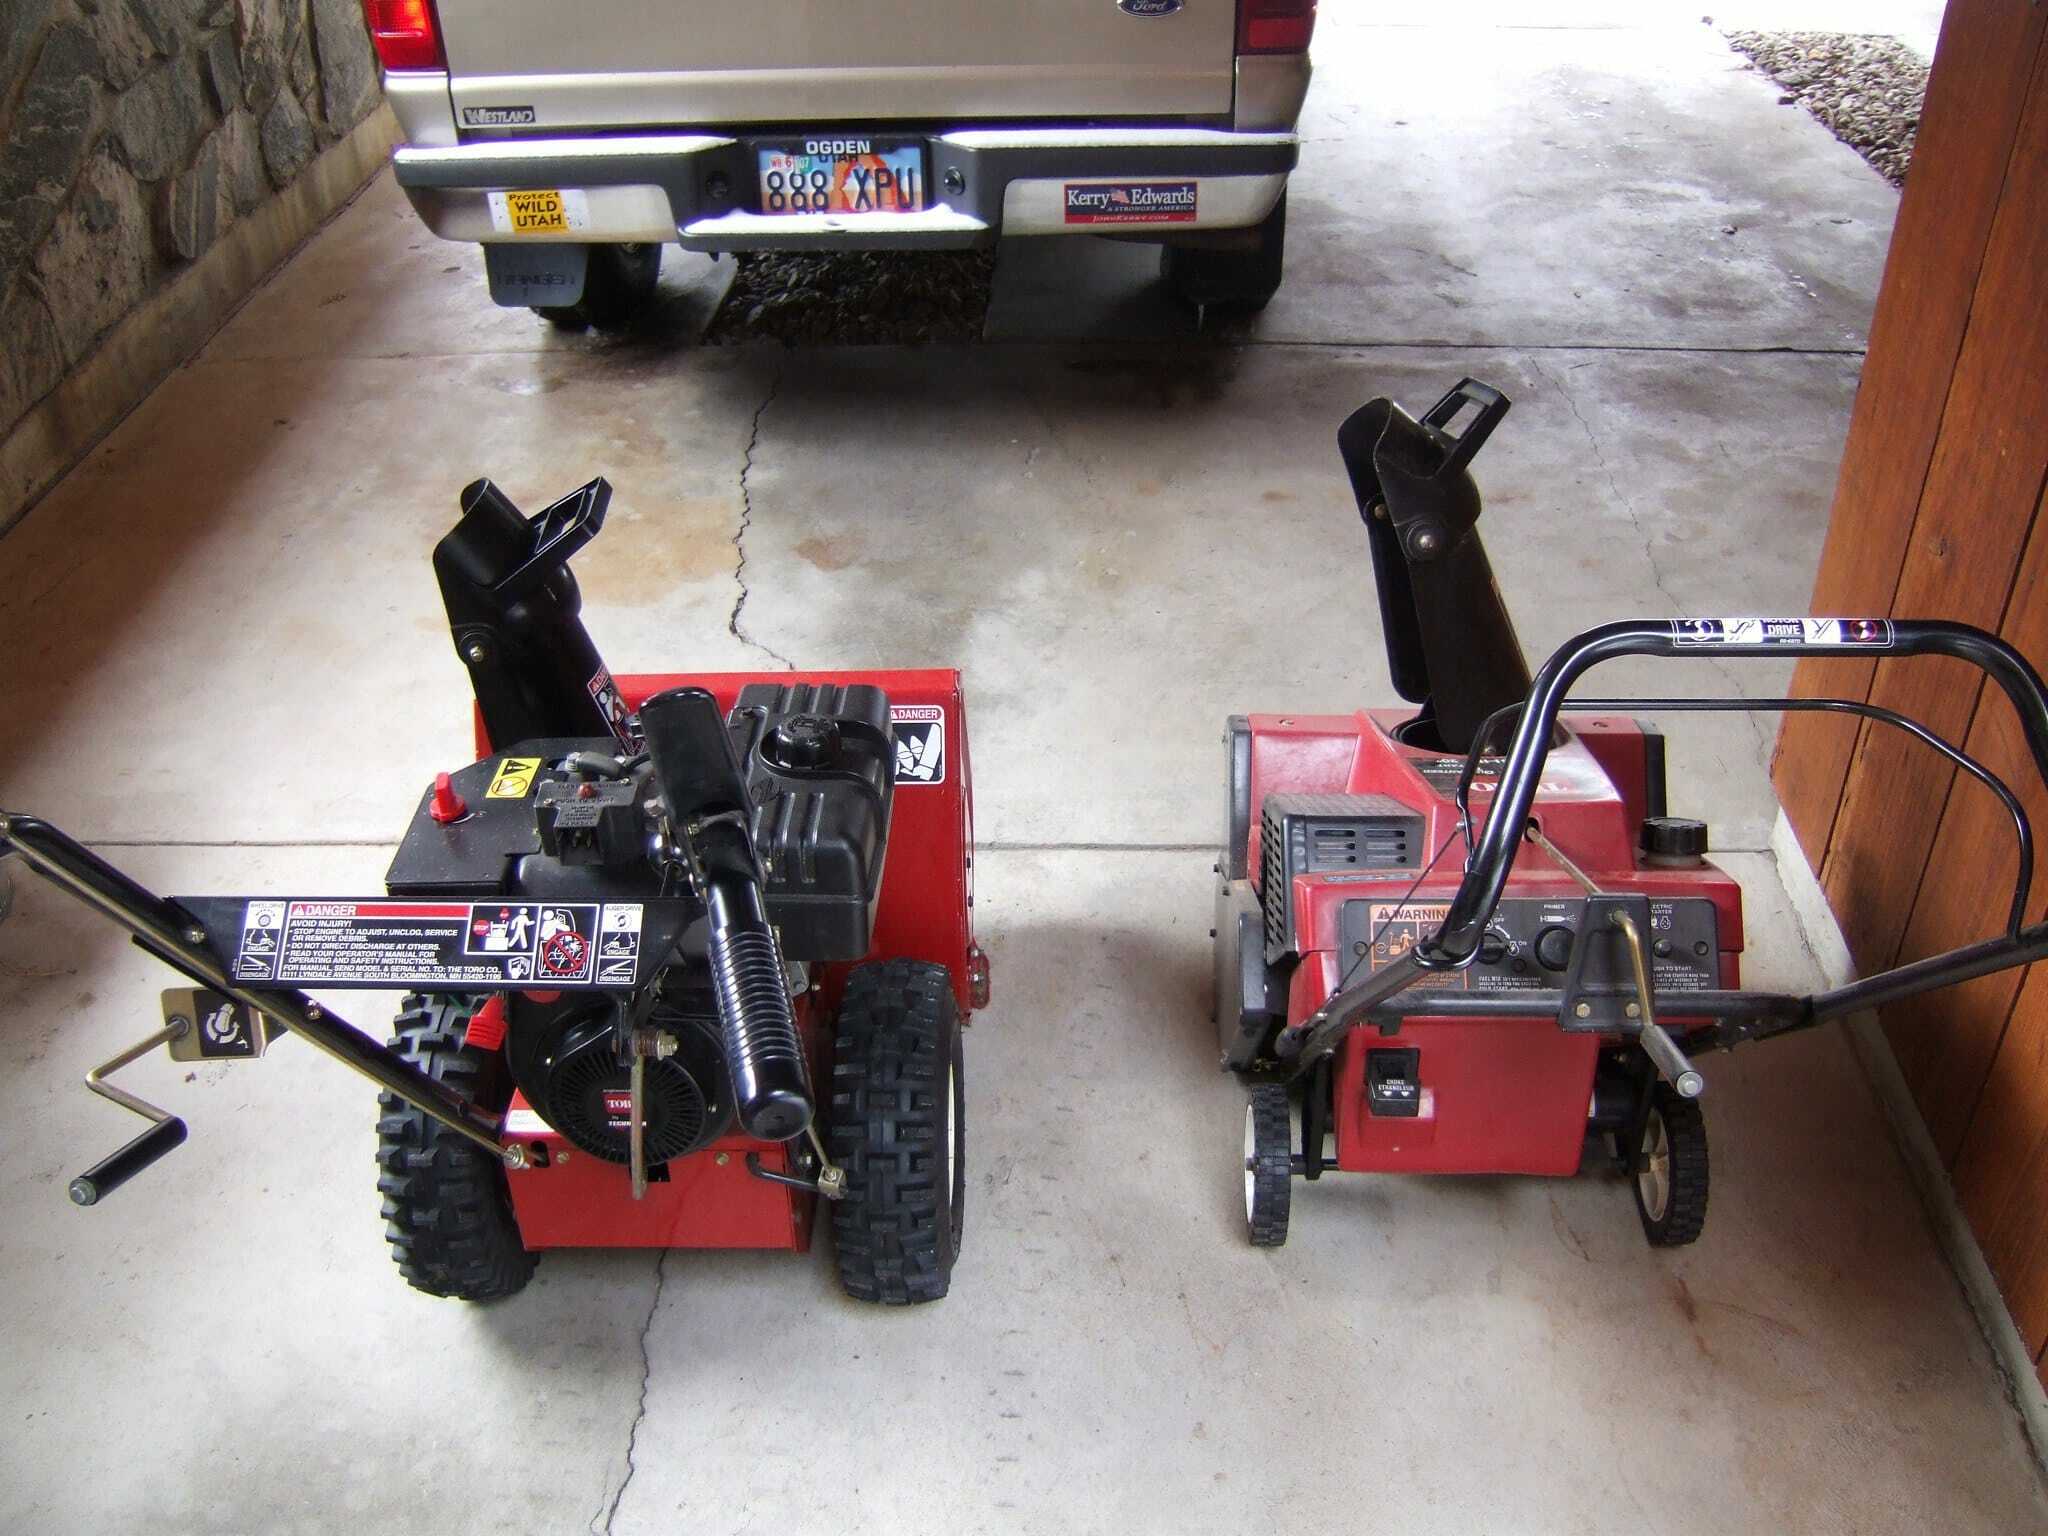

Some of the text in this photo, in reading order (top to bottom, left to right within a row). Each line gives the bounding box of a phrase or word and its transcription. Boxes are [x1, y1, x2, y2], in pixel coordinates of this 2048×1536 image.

[464, 108, 533, 123] WESTLAND
[806, 140, 870, 154] OGDEN
[767, 167, 914, 211] 888 XPU
[1067, 186, 1195, 209] Kerry Edwards
[514, 200, 557, 213] WILD
[516, 214, 562, 227] UTAH
[1767, 624, 1801, 635] DRIVE
[898, 709, 938, 720] DANGER
[306, 905, 357, 916] DANGER
[1391, 909, 1448, 920] WARNIN
[318, 920, 352, 928] INJURY!
[356, 929, 388, 937] ADJUST,
[425, 929, 459, 937] SERVICE
[607, 1099, 632, 1108] TOR
